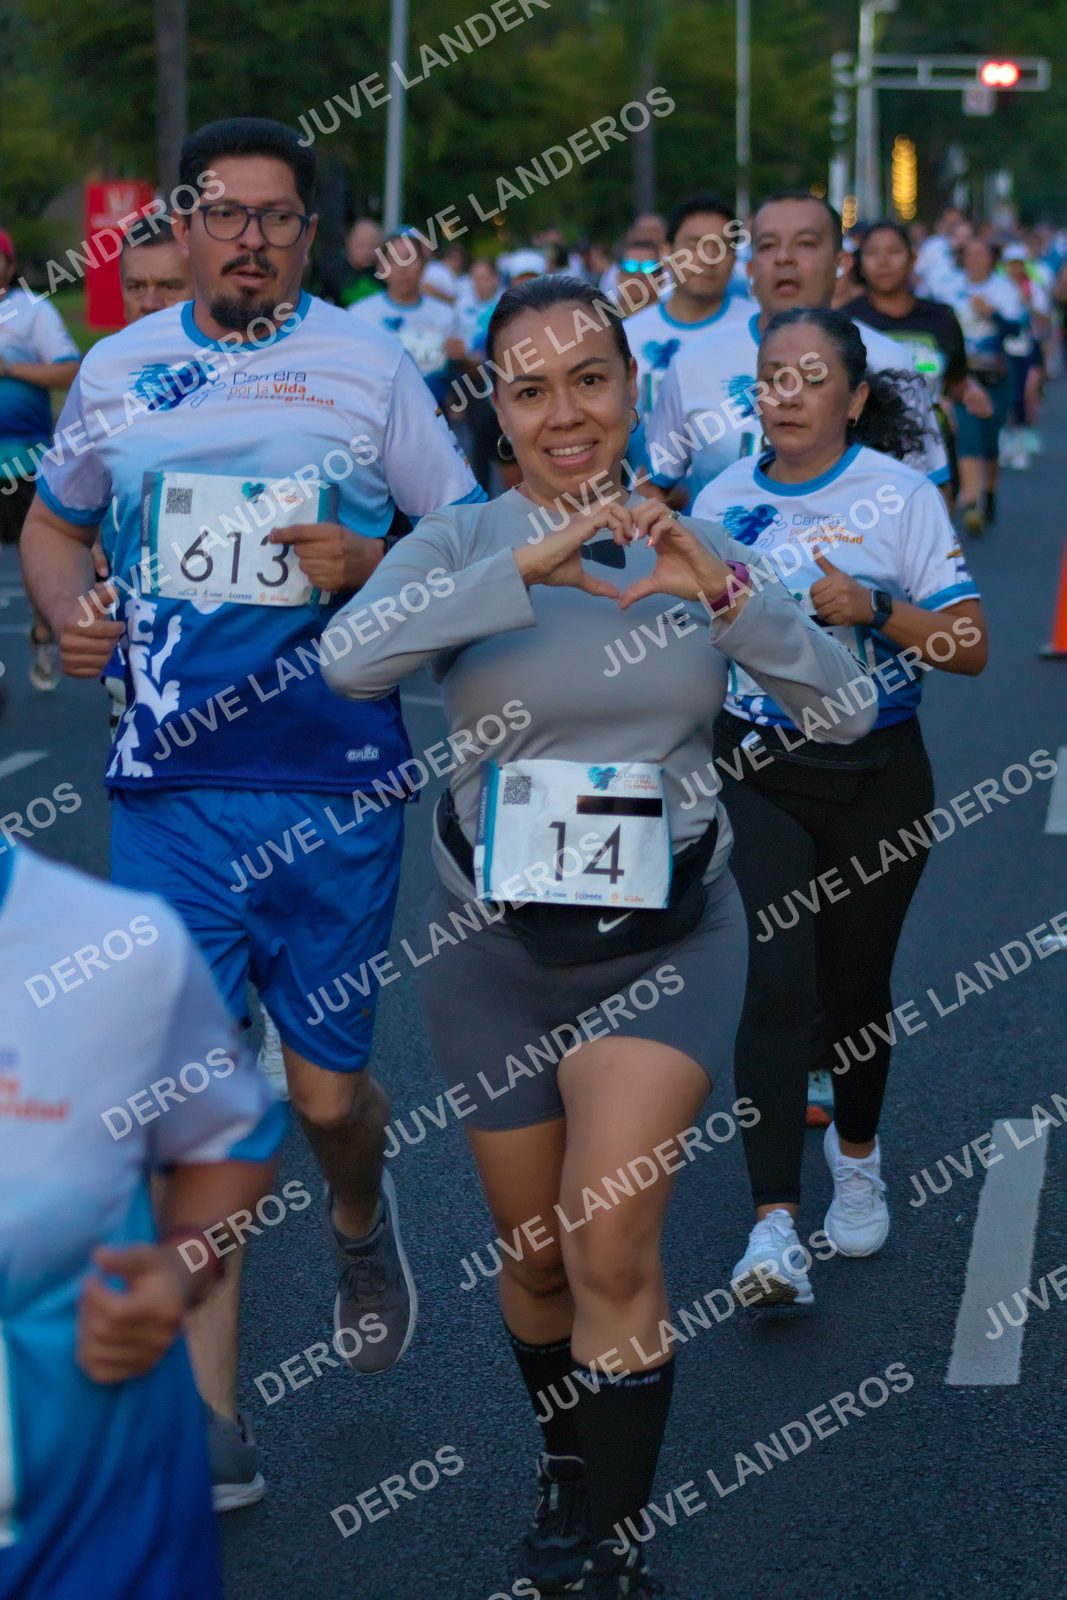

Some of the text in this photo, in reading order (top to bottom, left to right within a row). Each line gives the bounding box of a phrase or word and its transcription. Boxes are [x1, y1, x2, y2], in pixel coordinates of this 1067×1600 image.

[273, 383, 306, 394] Vida
[180, 530, 289, 587] 613
[549, 821, 624, 884] 14
